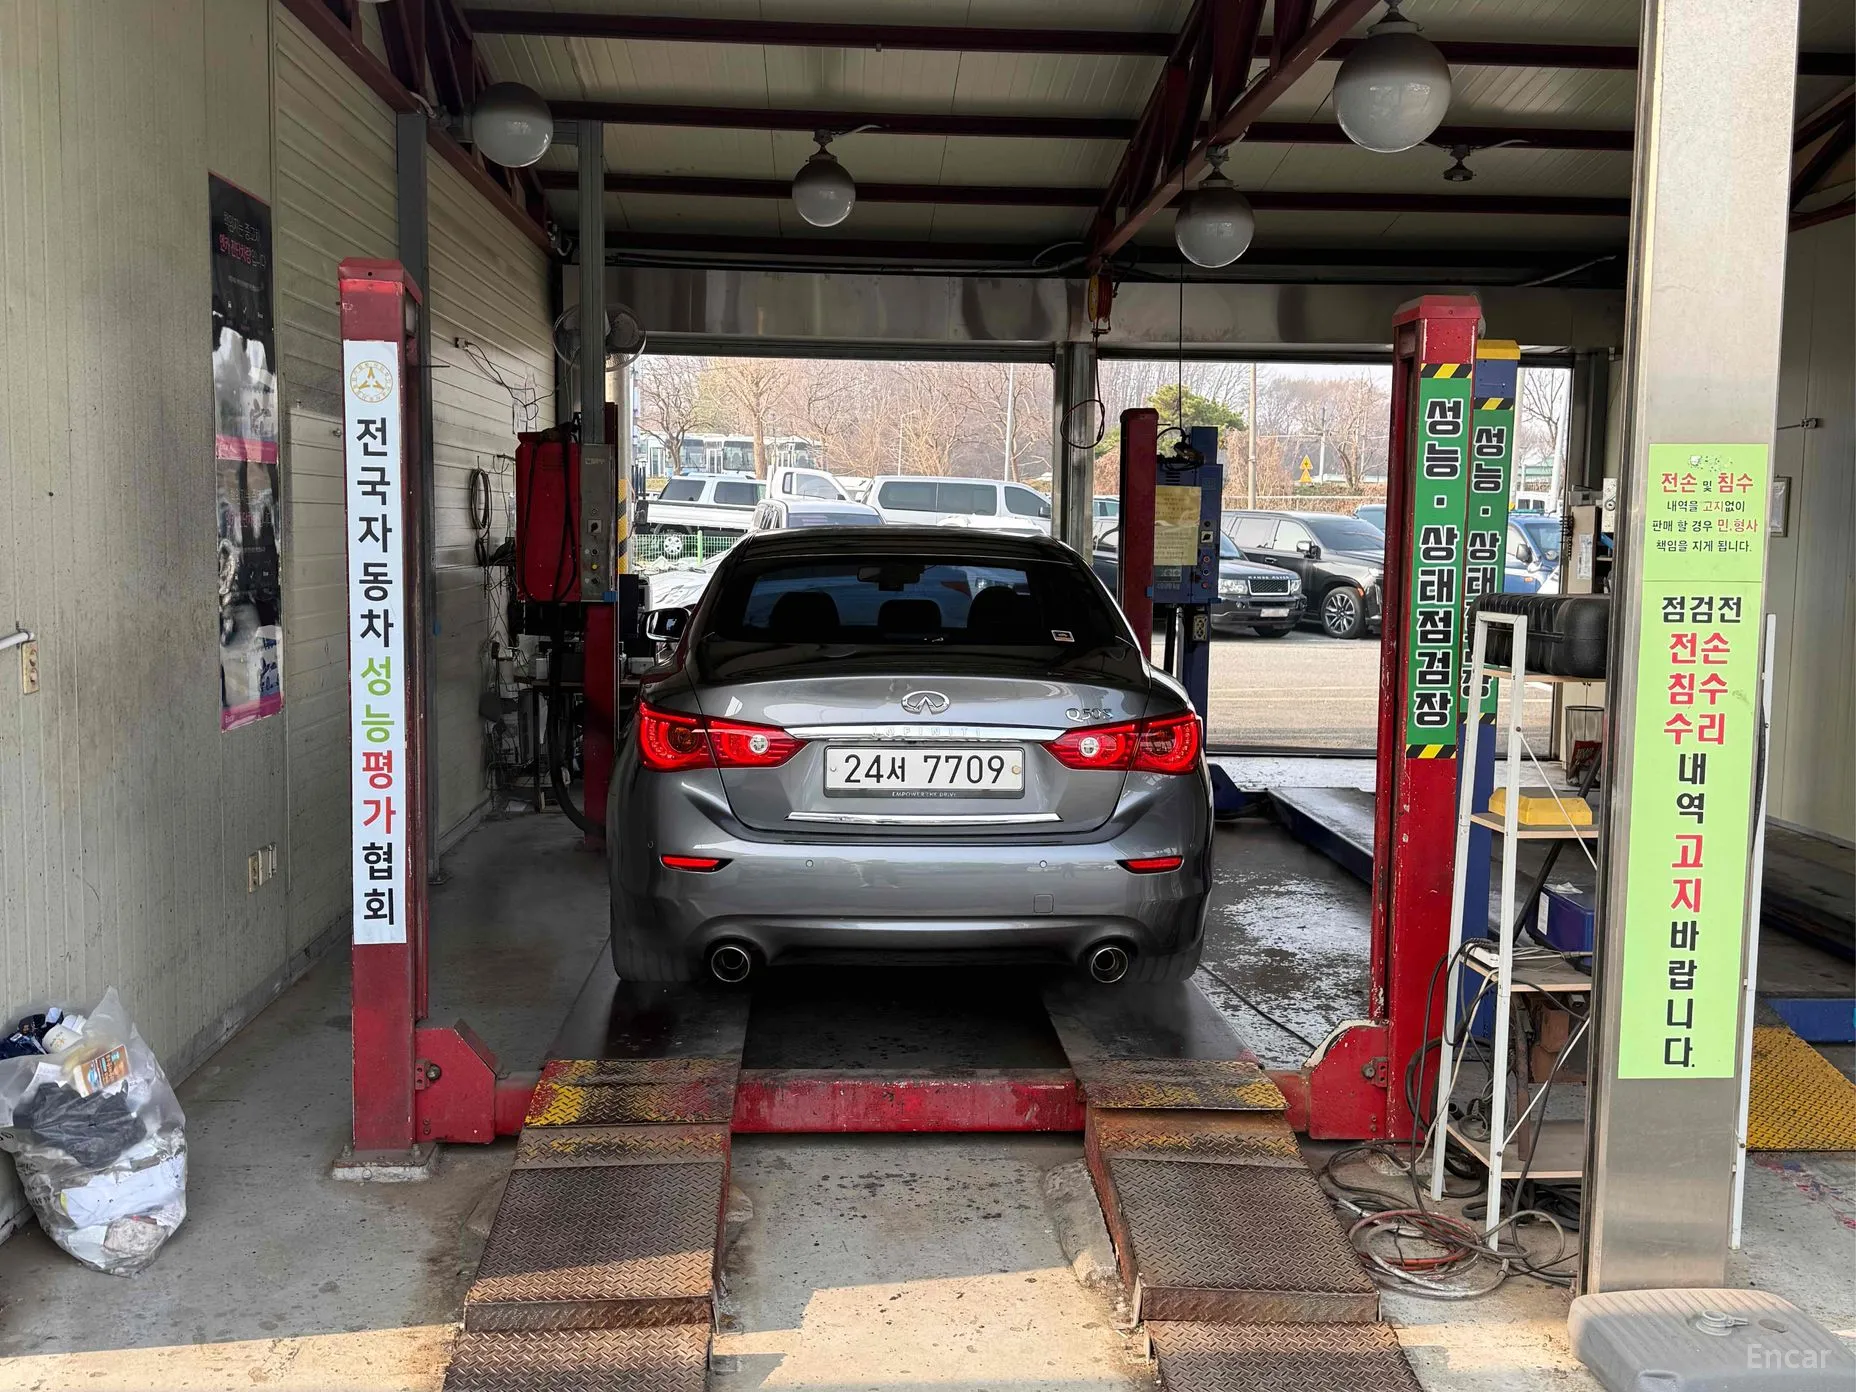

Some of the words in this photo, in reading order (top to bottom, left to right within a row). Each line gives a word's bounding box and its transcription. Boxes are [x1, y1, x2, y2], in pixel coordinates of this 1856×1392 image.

[1661, 472, 1698, 494] 전손
[1702, 480, 1713, 493] 및
[1717, 472, 1754, 494] 침수
[1667, 500, 1699, 512] 내역을
[1702, 500, 1745, 513] 고지없이
[1652, 520, 1673, 532] 판매
[1677, 520, 1688, 532] 할
[1692, 520, 1713, 532] 경우
[1656, 539, 1688, 552] 책임을
[1692, 540, 1713, 552] 지게
[1717, 540, 1752, 552] 됩니다.
[1662, 596, 1741, 624] 점검전
[1669, 632, 1730, 665] 전손
[1667, 672, 1728, 705] 침수
[1664, 712, 1725, 745] 수리
[844, 754, 906, 784] 24서
[923, 754, 1005, 784] 7709
